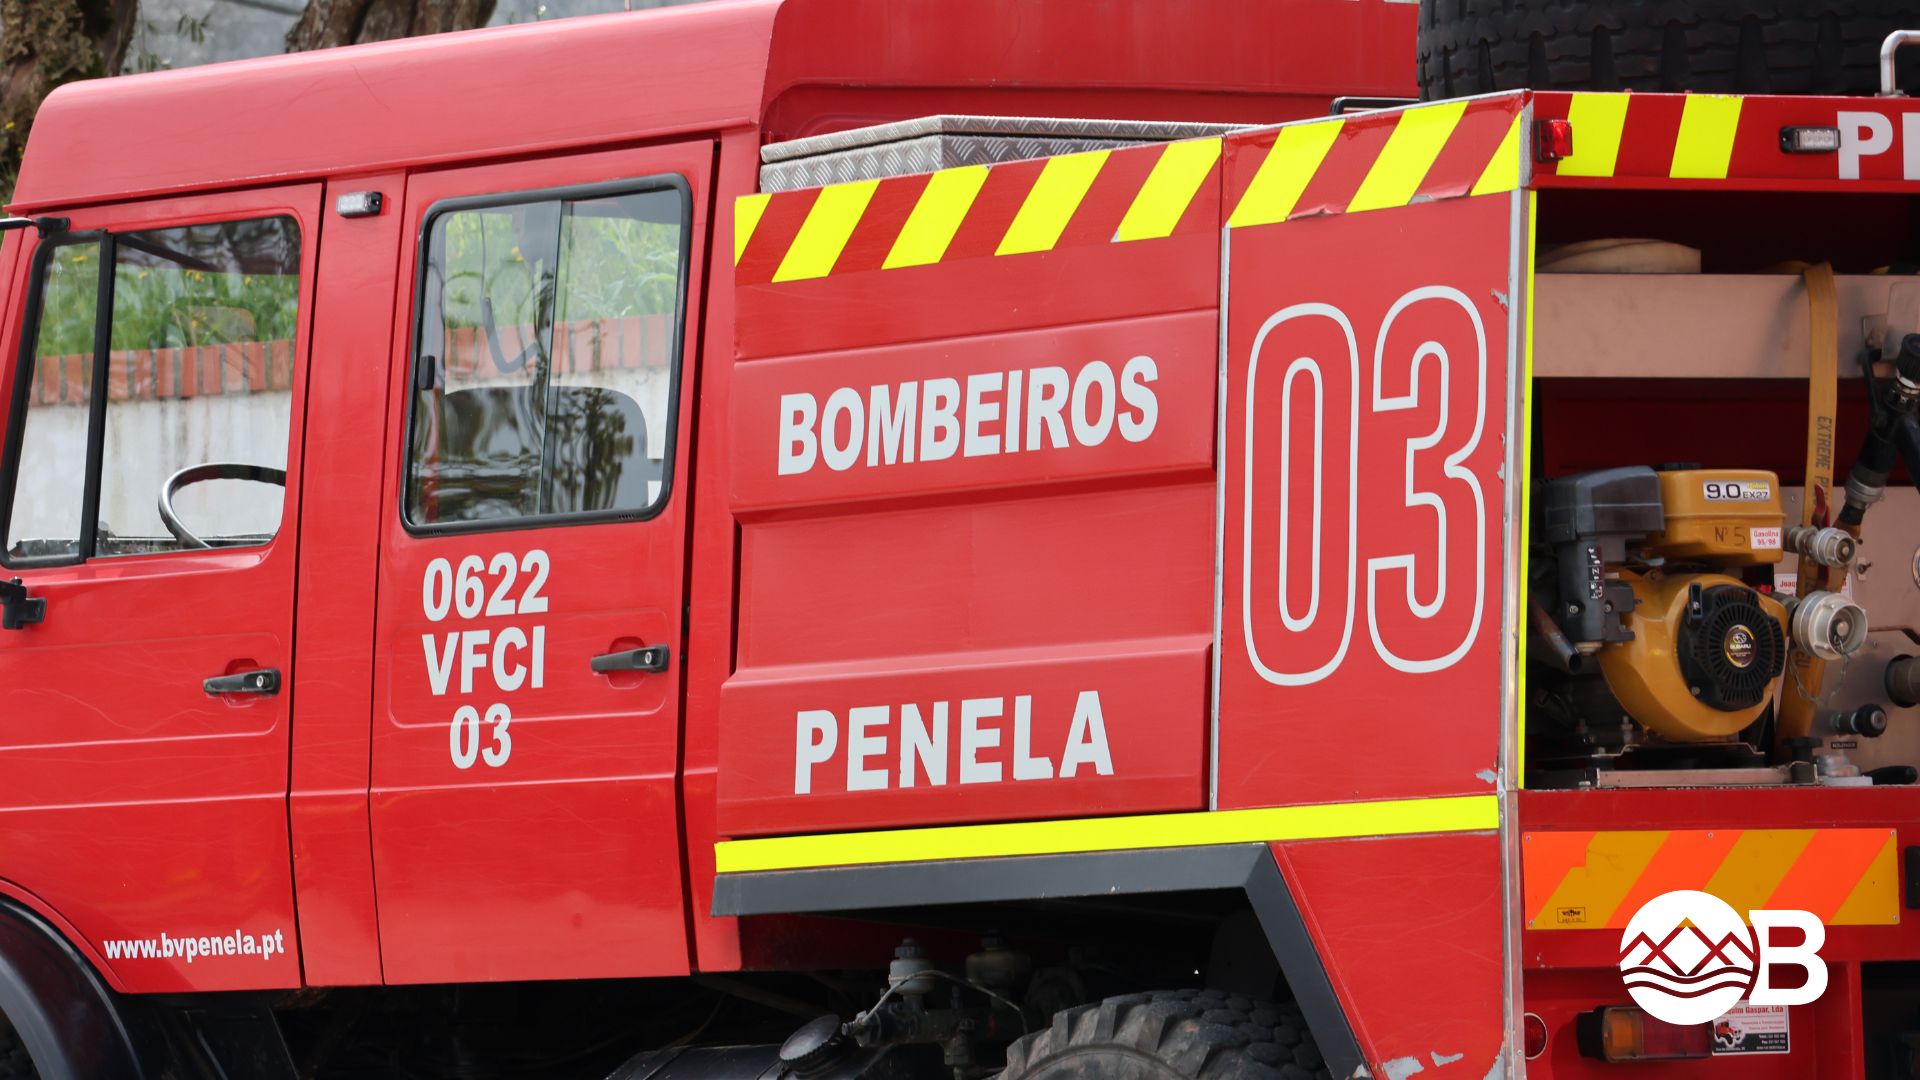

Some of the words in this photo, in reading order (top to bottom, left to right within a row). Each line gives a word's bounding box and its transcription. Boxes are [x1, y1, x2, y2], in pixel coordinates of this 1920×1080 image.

[778, 355, 1159, 476] BOMBEIROS
[1815, 415, 1832, 470] EXTREME
[1243, 285, 1487, 687] 03
[1706, 483, 1741, 499] 9.0
[1743, 491, 1768, 499] EX27
[422, 549, 550, 622] 0622
[421, 625, 546, 696] VFCI
[449, 702, 514, 769] 03
[795, 690, 1114, 795] PENELA
[103, 928, 285, 963] www.bvpenela.pt
